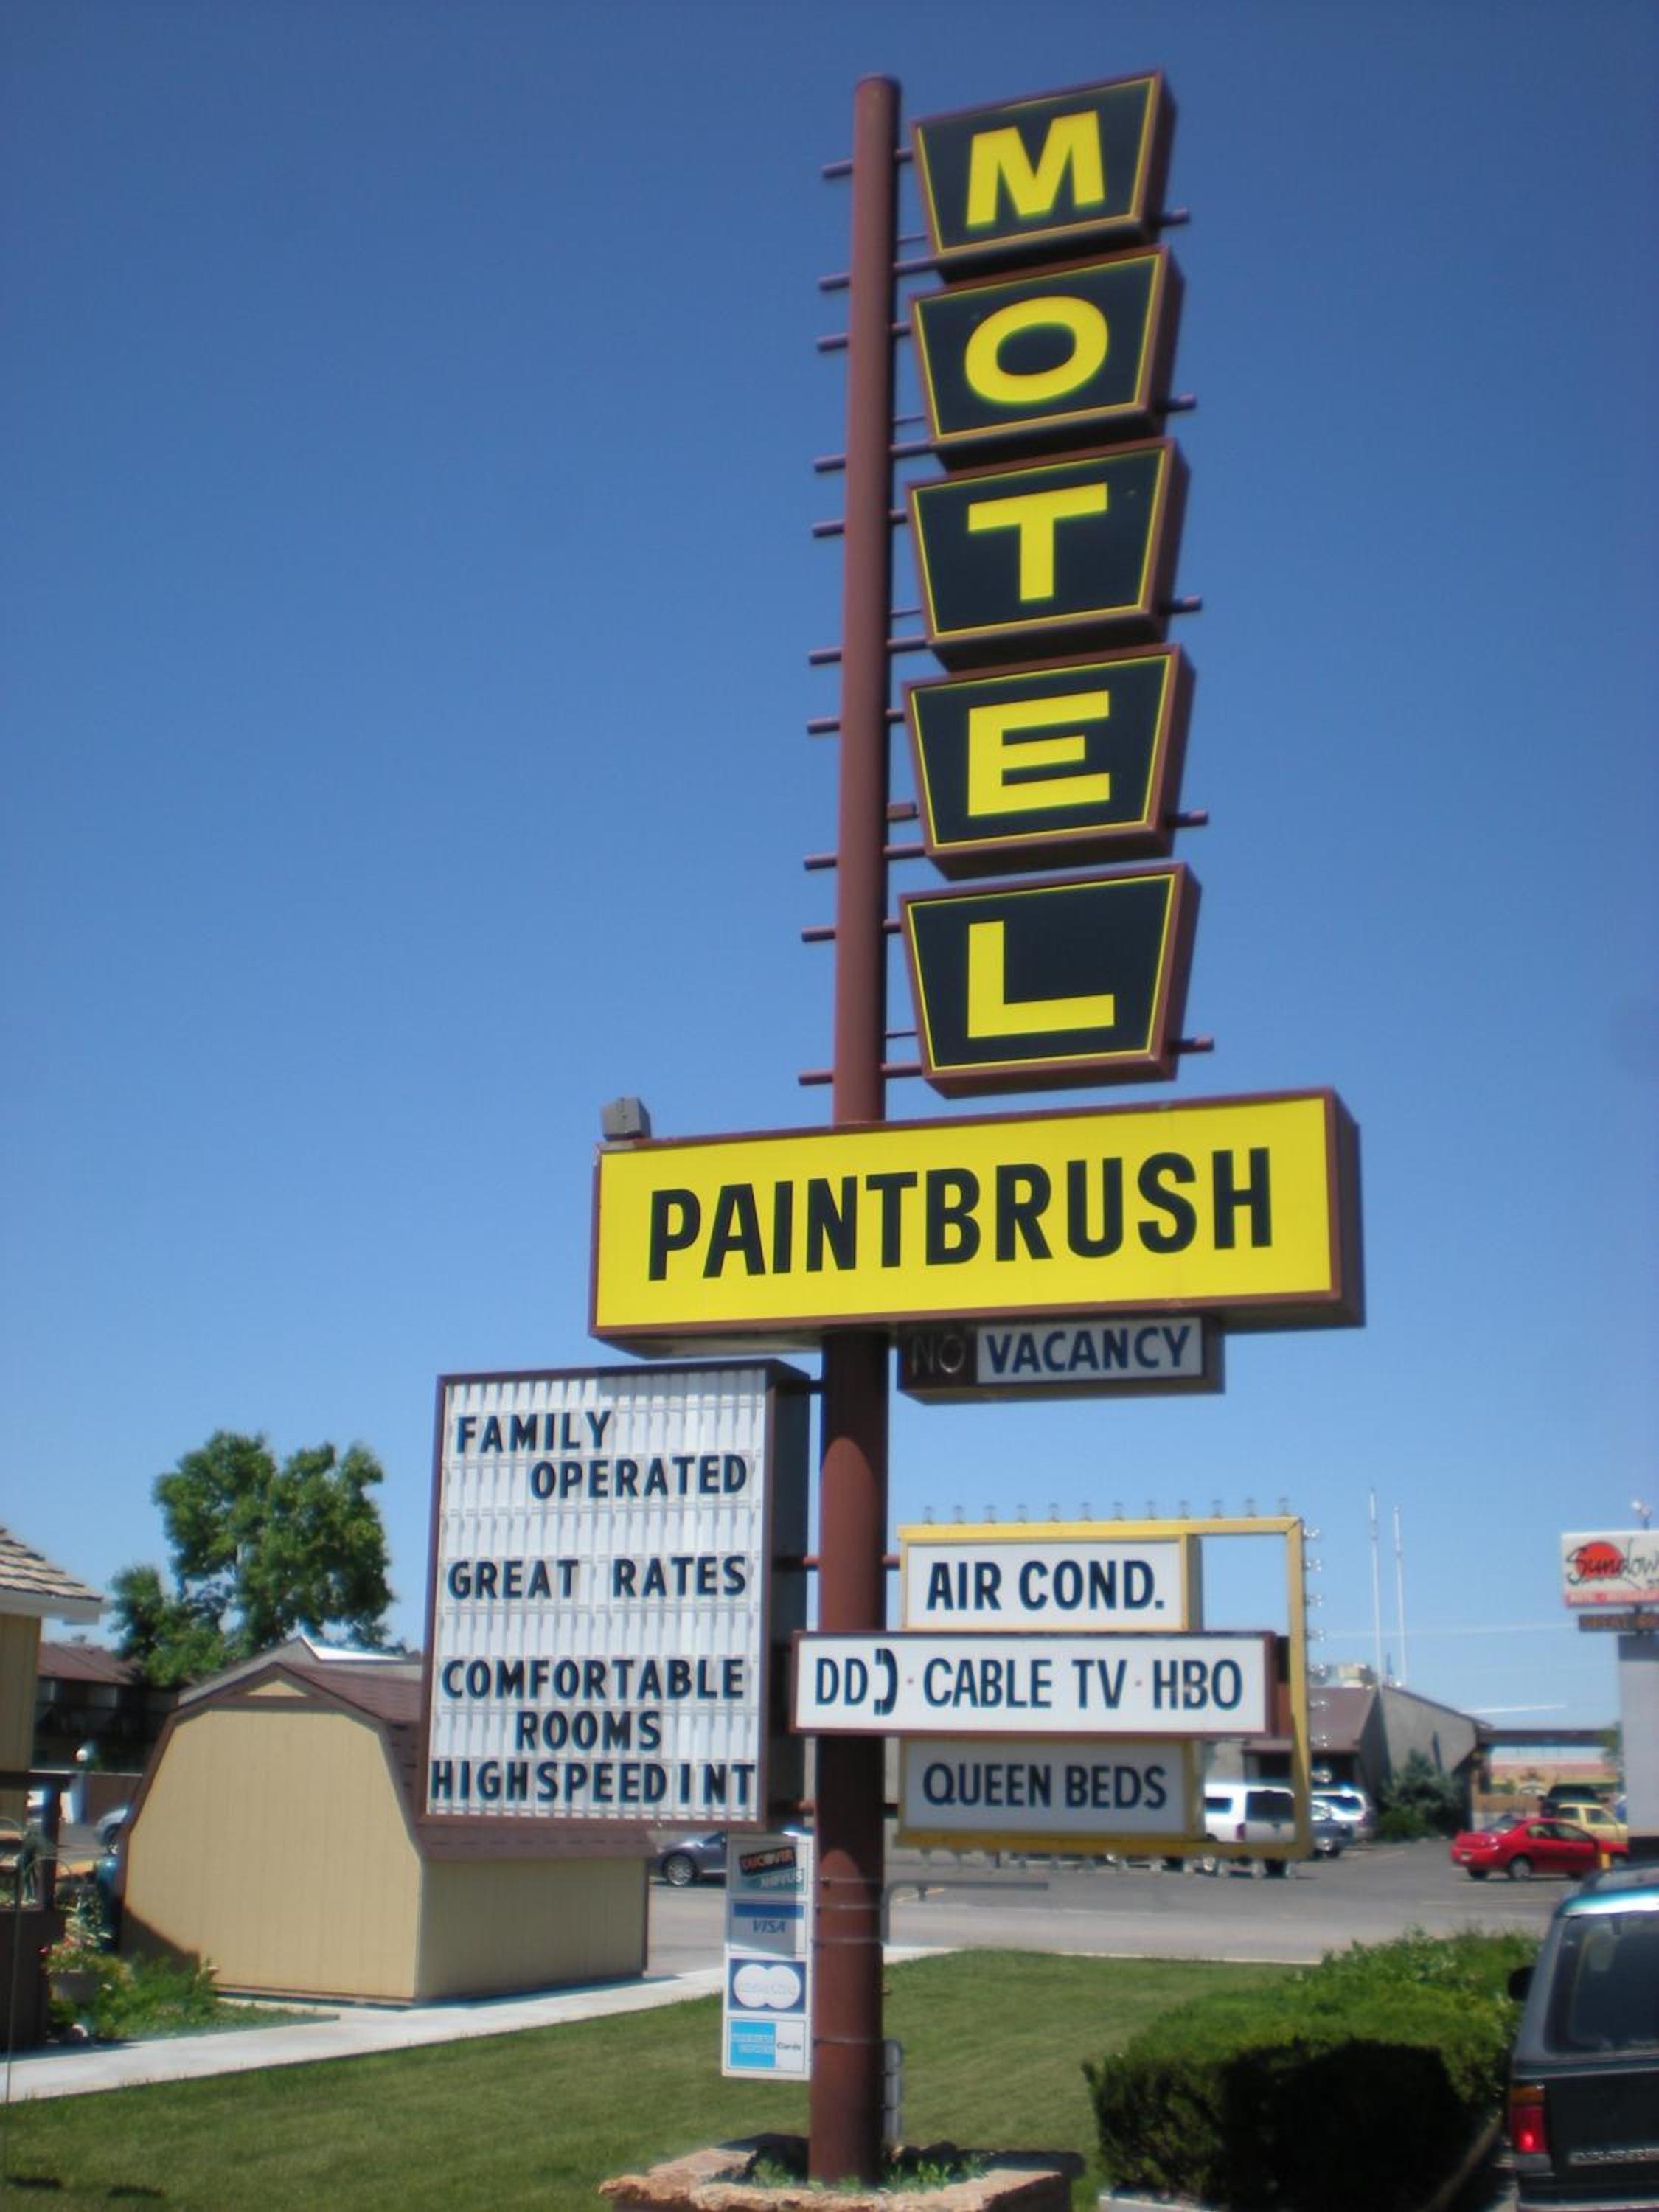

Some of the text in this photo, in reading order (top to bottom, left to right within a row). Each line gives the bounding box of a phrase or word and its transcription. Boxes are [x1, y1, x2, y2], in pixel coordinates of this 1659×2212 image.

[964, 109, 1115, 1039] MOTEL
[648, 1147, 1273, 1281] PAINTBRUSH
[911, 1324, 1191, 1376] NO VACANCY
[456, 1411, 611, 1454] FAMILY
[530, 1454, 748, 1500] OPERATED
[448, 1555, 746, 1600] GREAT RATES
[926, 1559, 1164, 1610] AIR COND.
[442, 1658, 745, 1700] COMFORTABLE
[923, 1658, 1052, 1709] CABLE
[1071, 1658, 1126, 1710] TV
[1153, 1658, 1242, 1711] HBO
[516, 1710, 661, 1751] ROOMS
[680, 1763, 755, 1806] INT
[923, 1762, 1167, 1810] QUEEN BEDS
[752, 1919, 787, 1934] VISA
